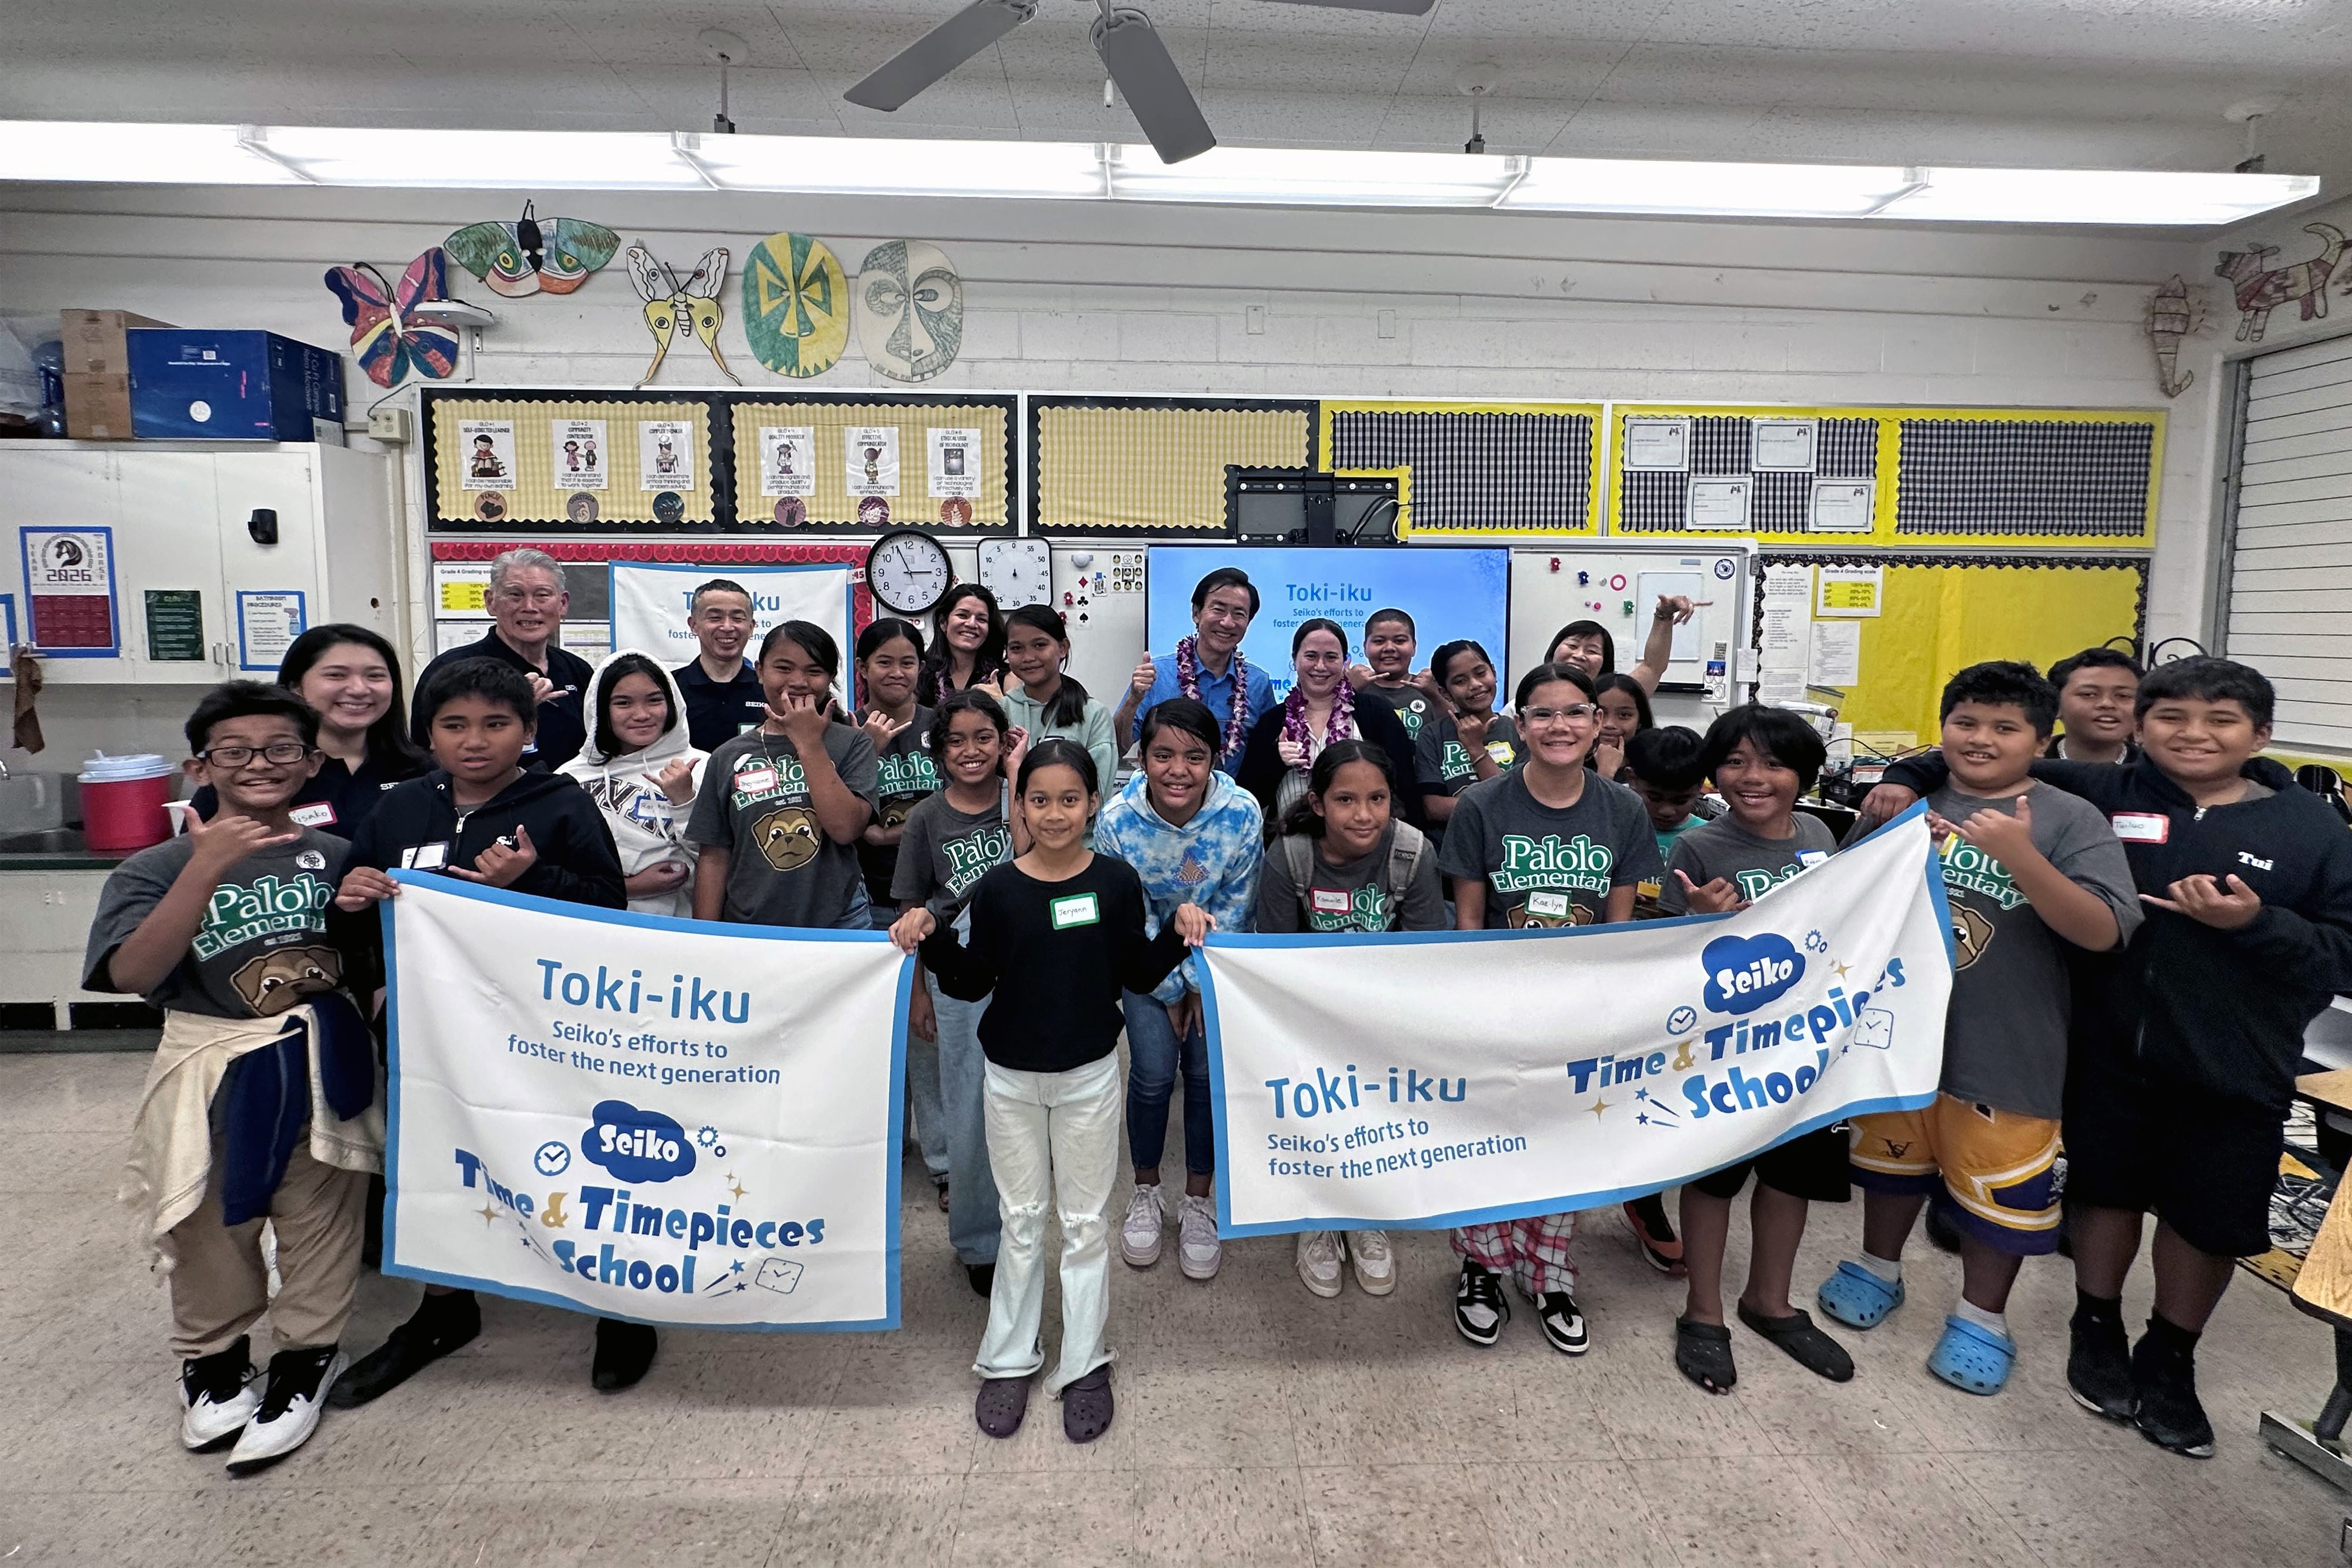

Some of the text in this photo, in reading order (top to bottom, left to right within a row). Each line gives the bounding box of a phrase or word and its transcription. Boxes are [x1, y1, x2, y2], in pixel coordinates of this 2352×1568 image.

[904, 541, 914, 550] 12
[920, 545, 924, 554] 1
[882, 554, 891, 563] 10
[930, 554, 937, 563] 2
[46, 569, 92, 582] 2026
[878, 568, 884, 577] 9
[936, 568, 942, 577] 3
[883, 581, 890, 591] 8
[894, 591, 901, 600] 7
[922, 591, 928, 600] 5
[931, 581, 938, 590] 4
[1286, 583, 1372, 601] Toki-iku
[908, 595, 914, 604] 6
[1293, 608, 1322, 616] Seiko's
[1324, 608, 1352, 616] efforts
[1273, 619, 1299, 628] foster
[1270, 679, 1291, 690] me
[947, 829, 1007, 870] Palol
[1506, 840, 1609, 871] Palolo
[2238, 850, 2274, 872] Tui
[1941, 868, 2029, 908] entary
[208, 877, 333, 927] Palolo
[1716, 956, 1794, 999] Seiko
[536, 958, 751, 1025] Toki-iku
[552, 1020, 729, 1059] Seiko's efforts to
[507, 1033, 781, 1086] foster the next generation
[1566, 1051, 1666, 1094] Time
[1672, 1040, 1695, 1072] &
[1265, 1064, 1466, 1119] Toki-iku
[1682, 1048, 1830, 1119] School
[599, 1123, 680, 1164] Seiko
[1267, 1119, 1429, 1154] Seiko's efforts to
[1268, 1134, 1528, 1179] foster the next generation
[455, 1147, 825, 1251] Time & Timepieces
[552, 1239, 696, 1295] School
